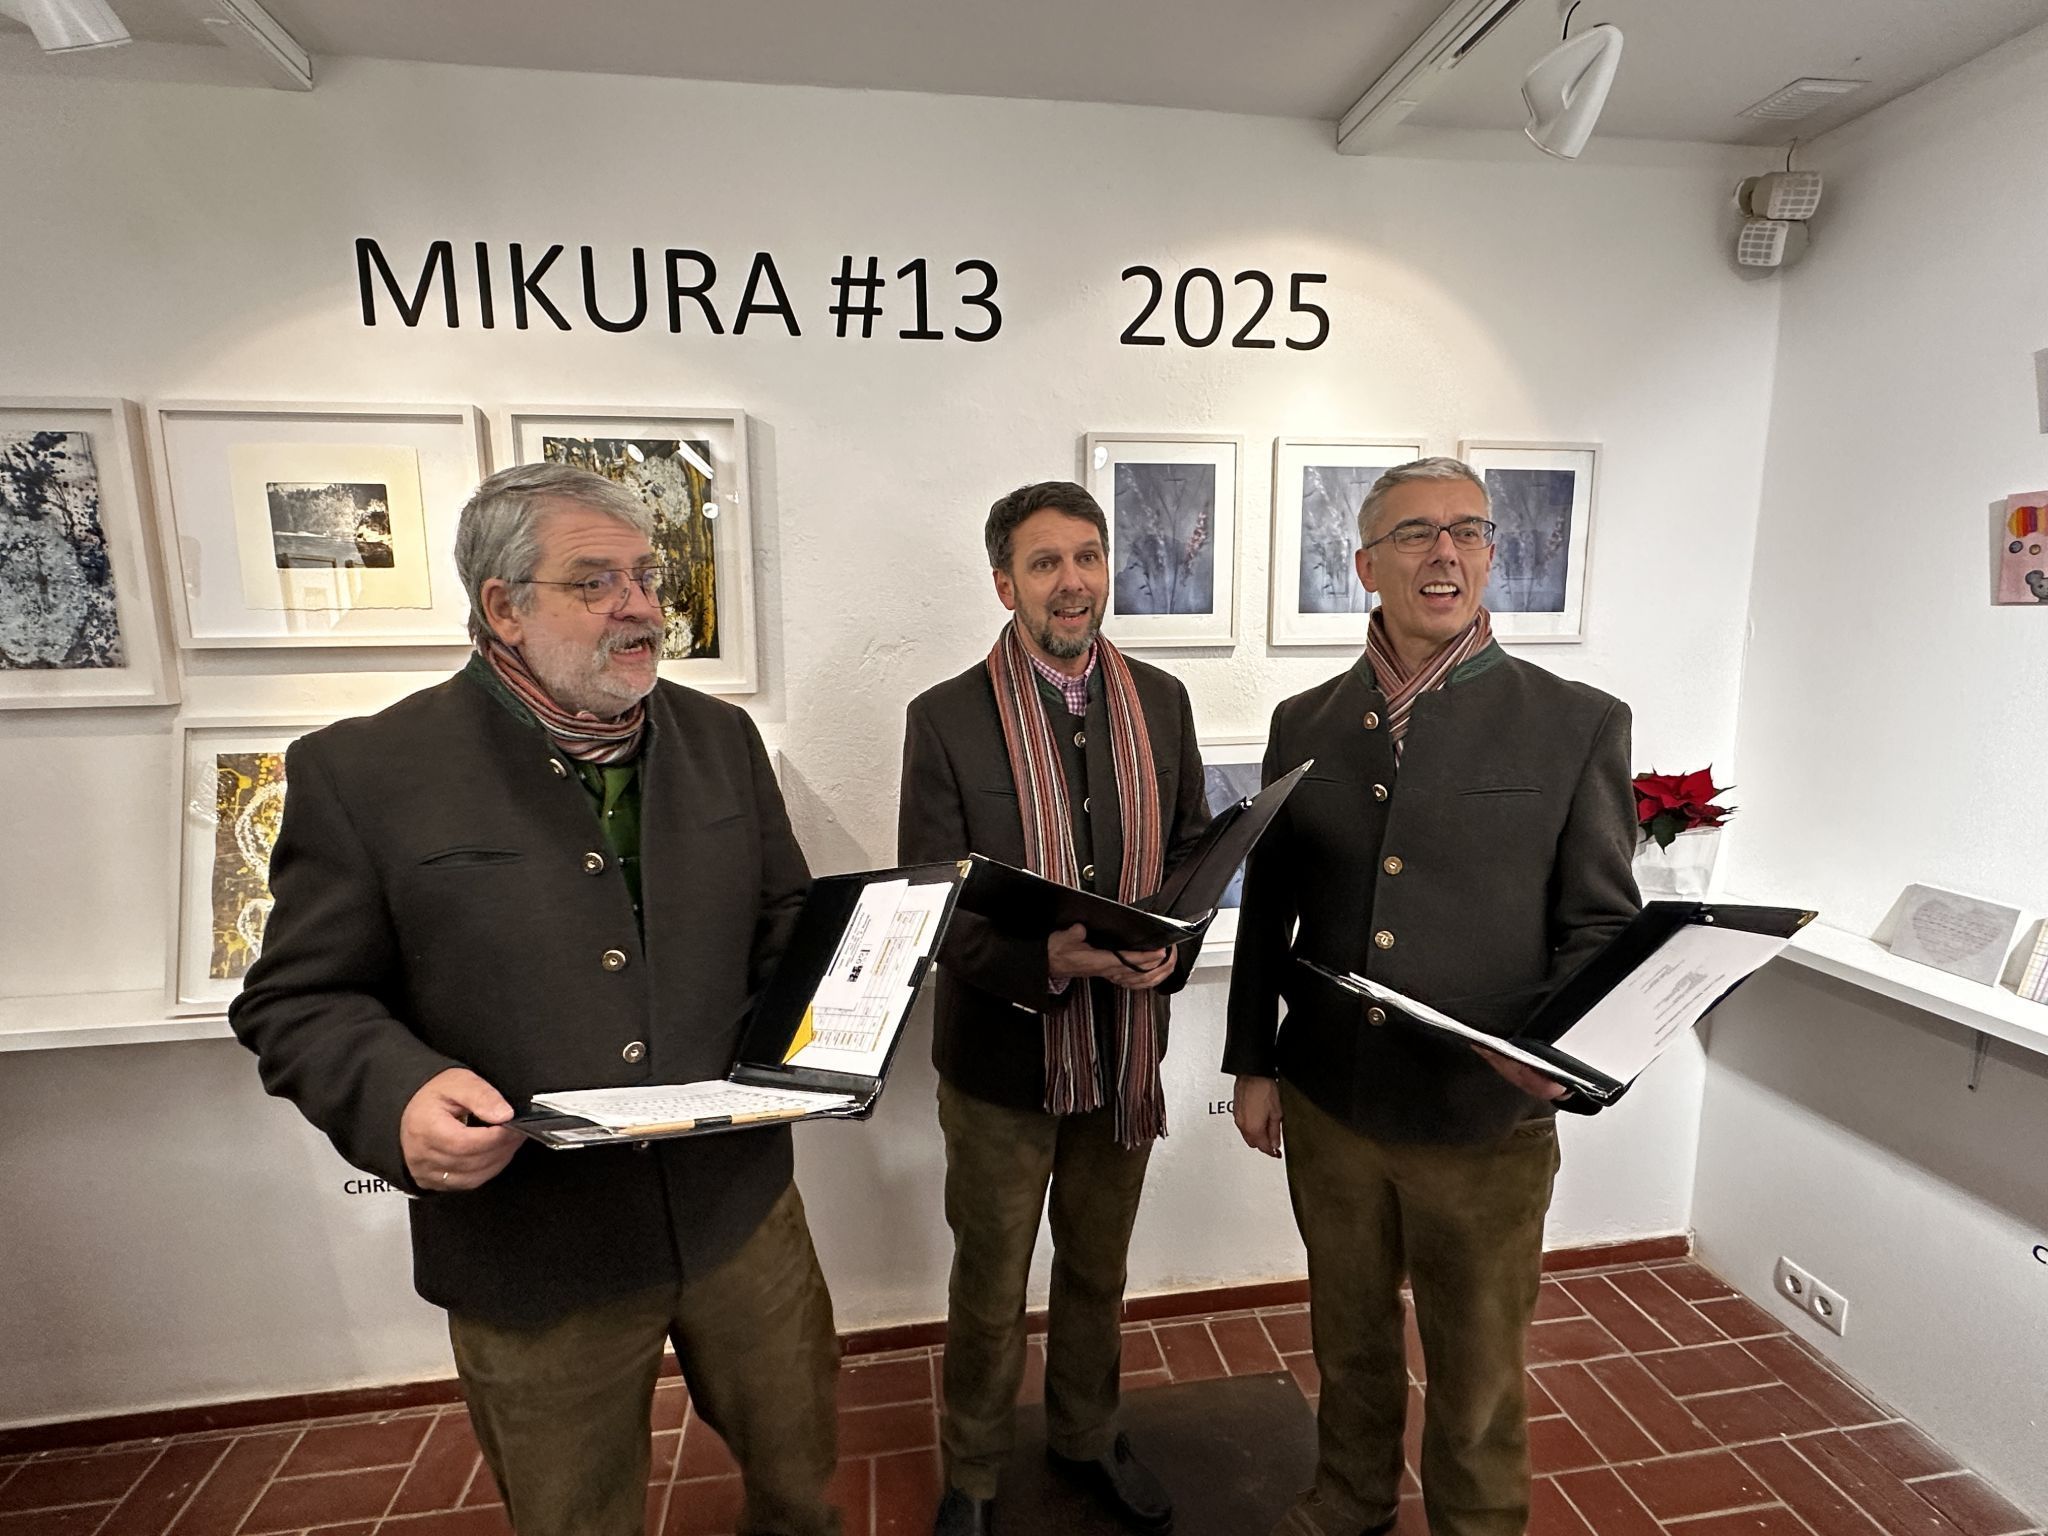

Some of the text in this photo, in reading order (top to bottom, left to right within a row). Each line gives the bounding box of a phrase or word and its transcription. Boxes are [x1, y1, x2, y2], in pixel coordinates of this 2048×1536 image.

[355, 237, 1330, 351] MIKURA #13 2025
